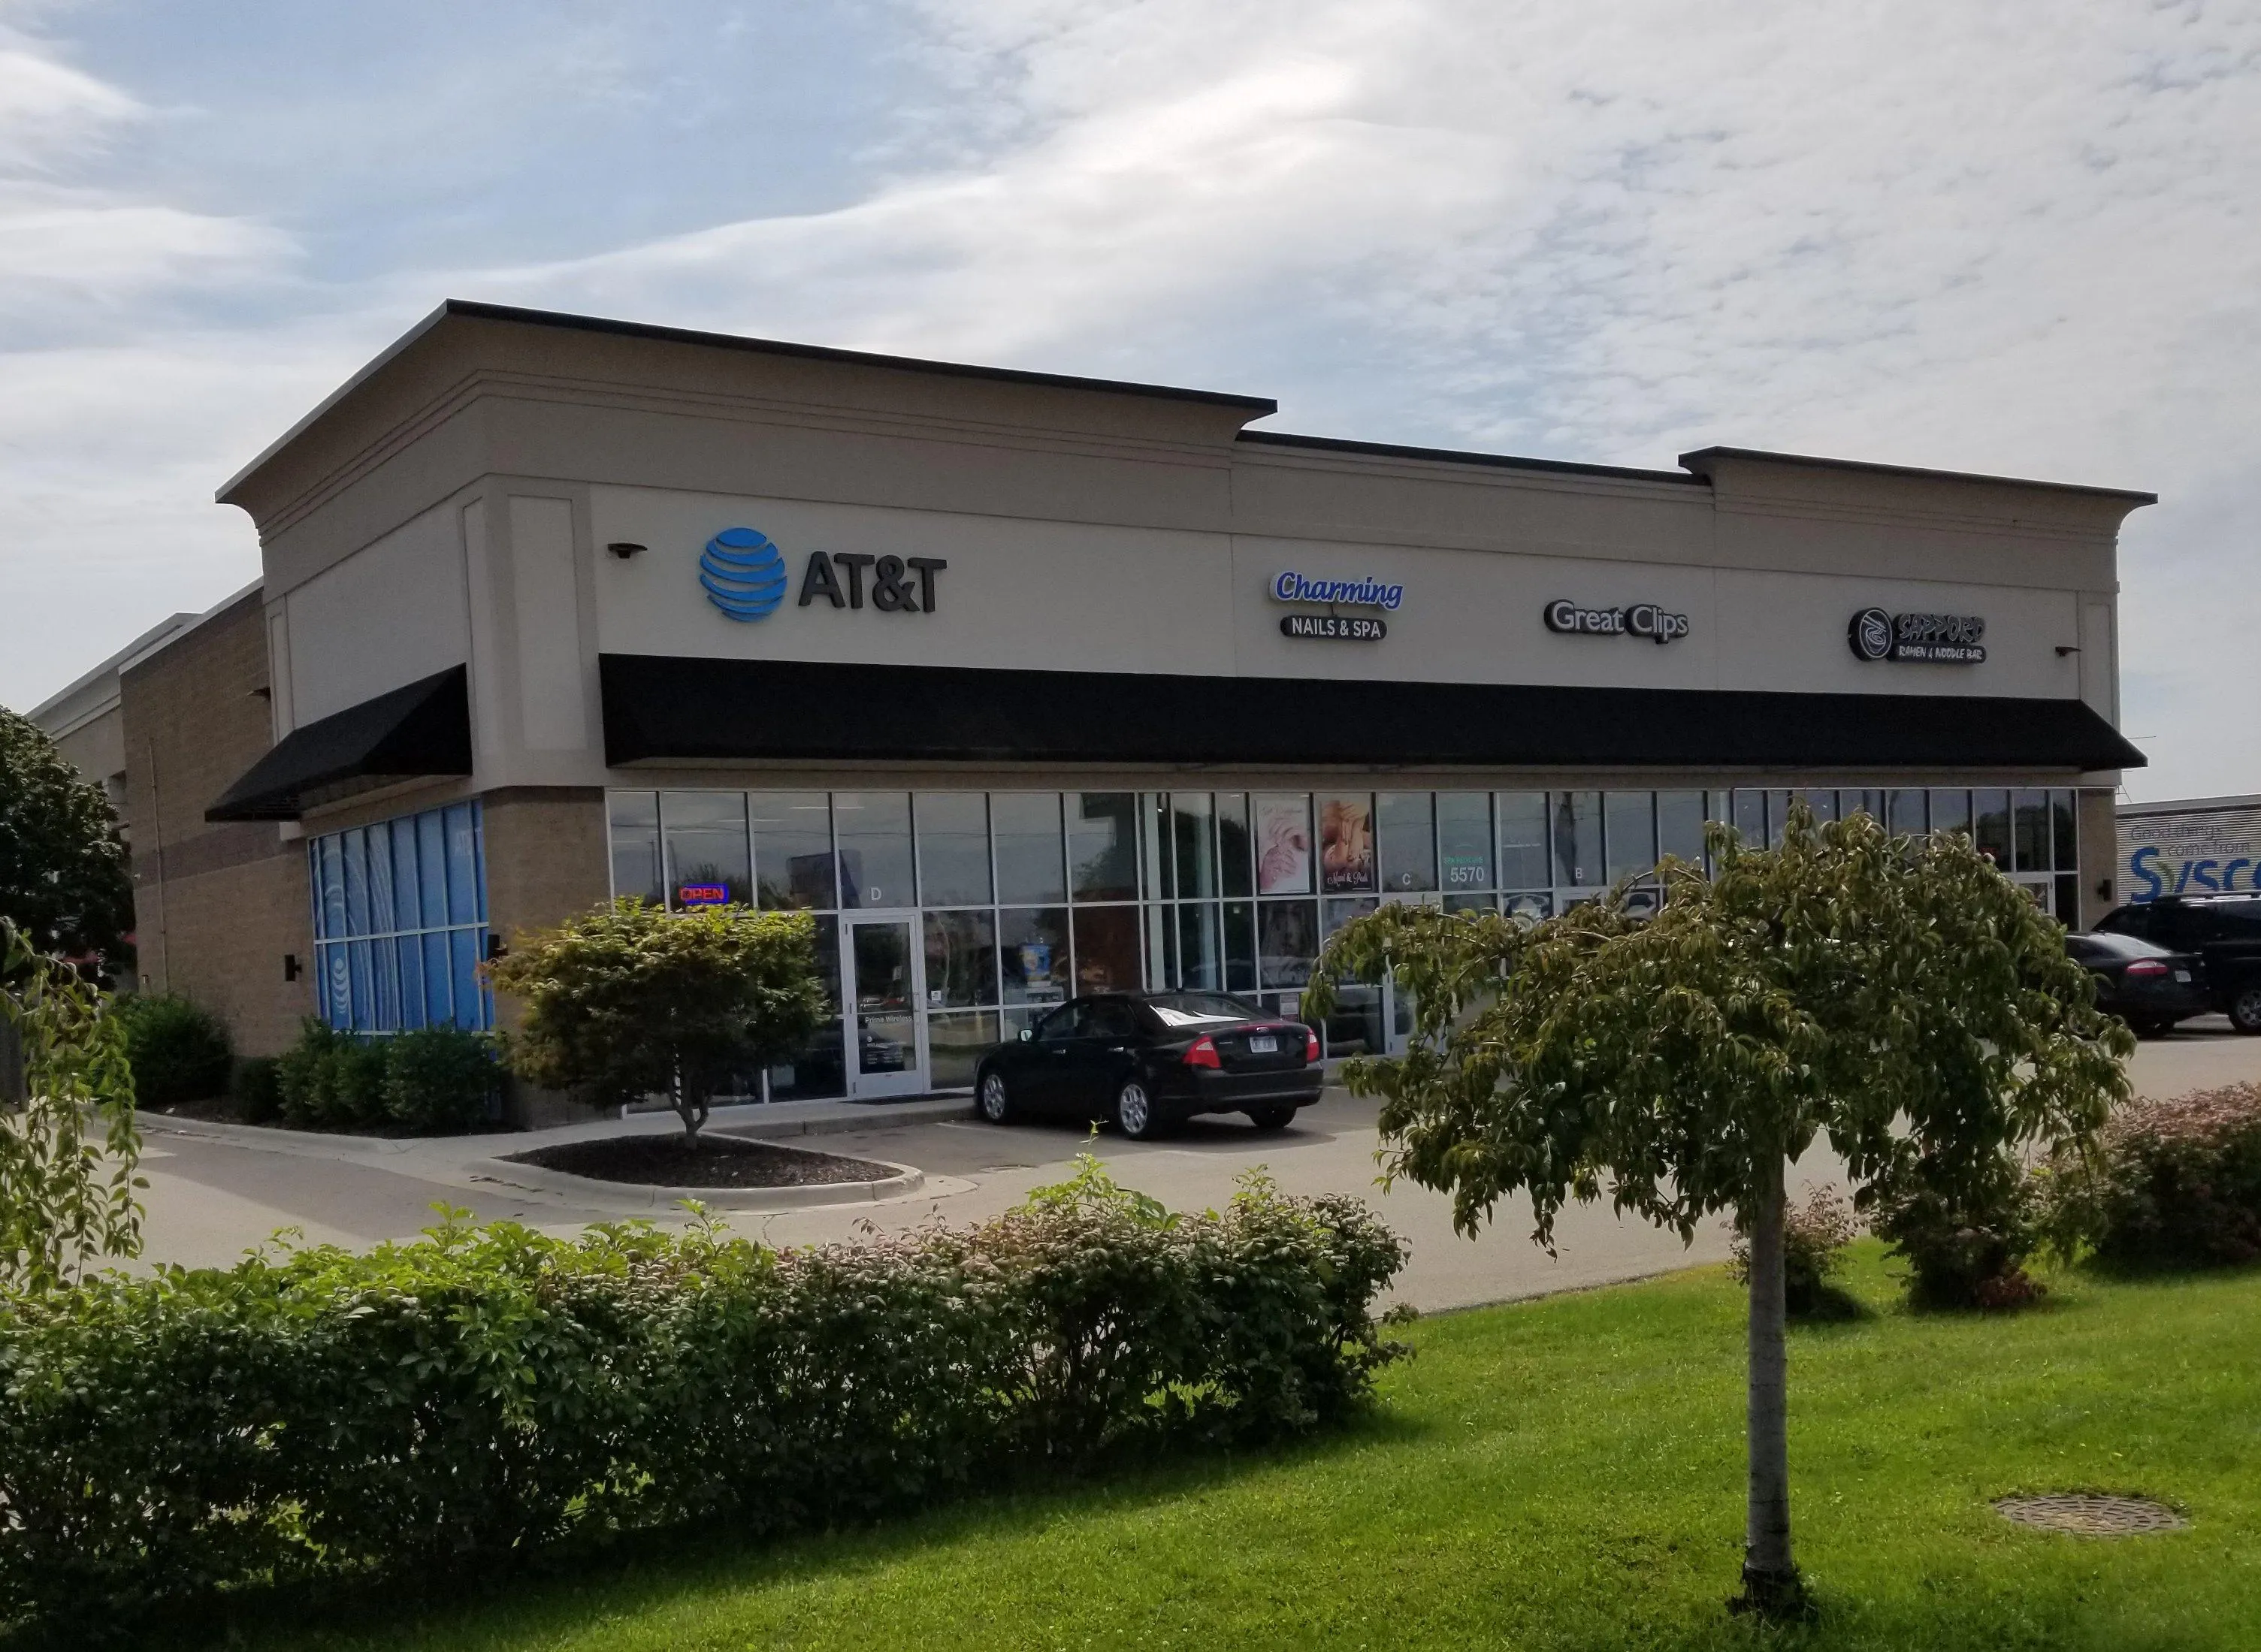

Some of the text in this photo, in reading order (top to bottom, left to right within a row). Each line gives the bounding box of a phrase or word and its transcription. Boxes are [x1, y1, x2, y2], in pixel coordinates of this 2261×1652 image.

[798, 551, 948, 613] AT&T
[1275, 571, 1404, 611] Charming
[1292, 618, 1381, 637] NAILS & SPA
[1552, 601, 1689, 642] Great Clips
[1898, 613, 1985, 642] SAPPORO
[1899, 645, 1926, 657] RAMEN
[1935, 648, 1965, 659] NOODLE
[1966, 649, 1982, 660] BAR
[1402, 873, 1410, 885] C
[1450, 865, 1484, 882] 5570
[1575, 867, 1582, 878] B
[680, 887, 724, 899] OPEN
[871, 887, 881, 901] D
